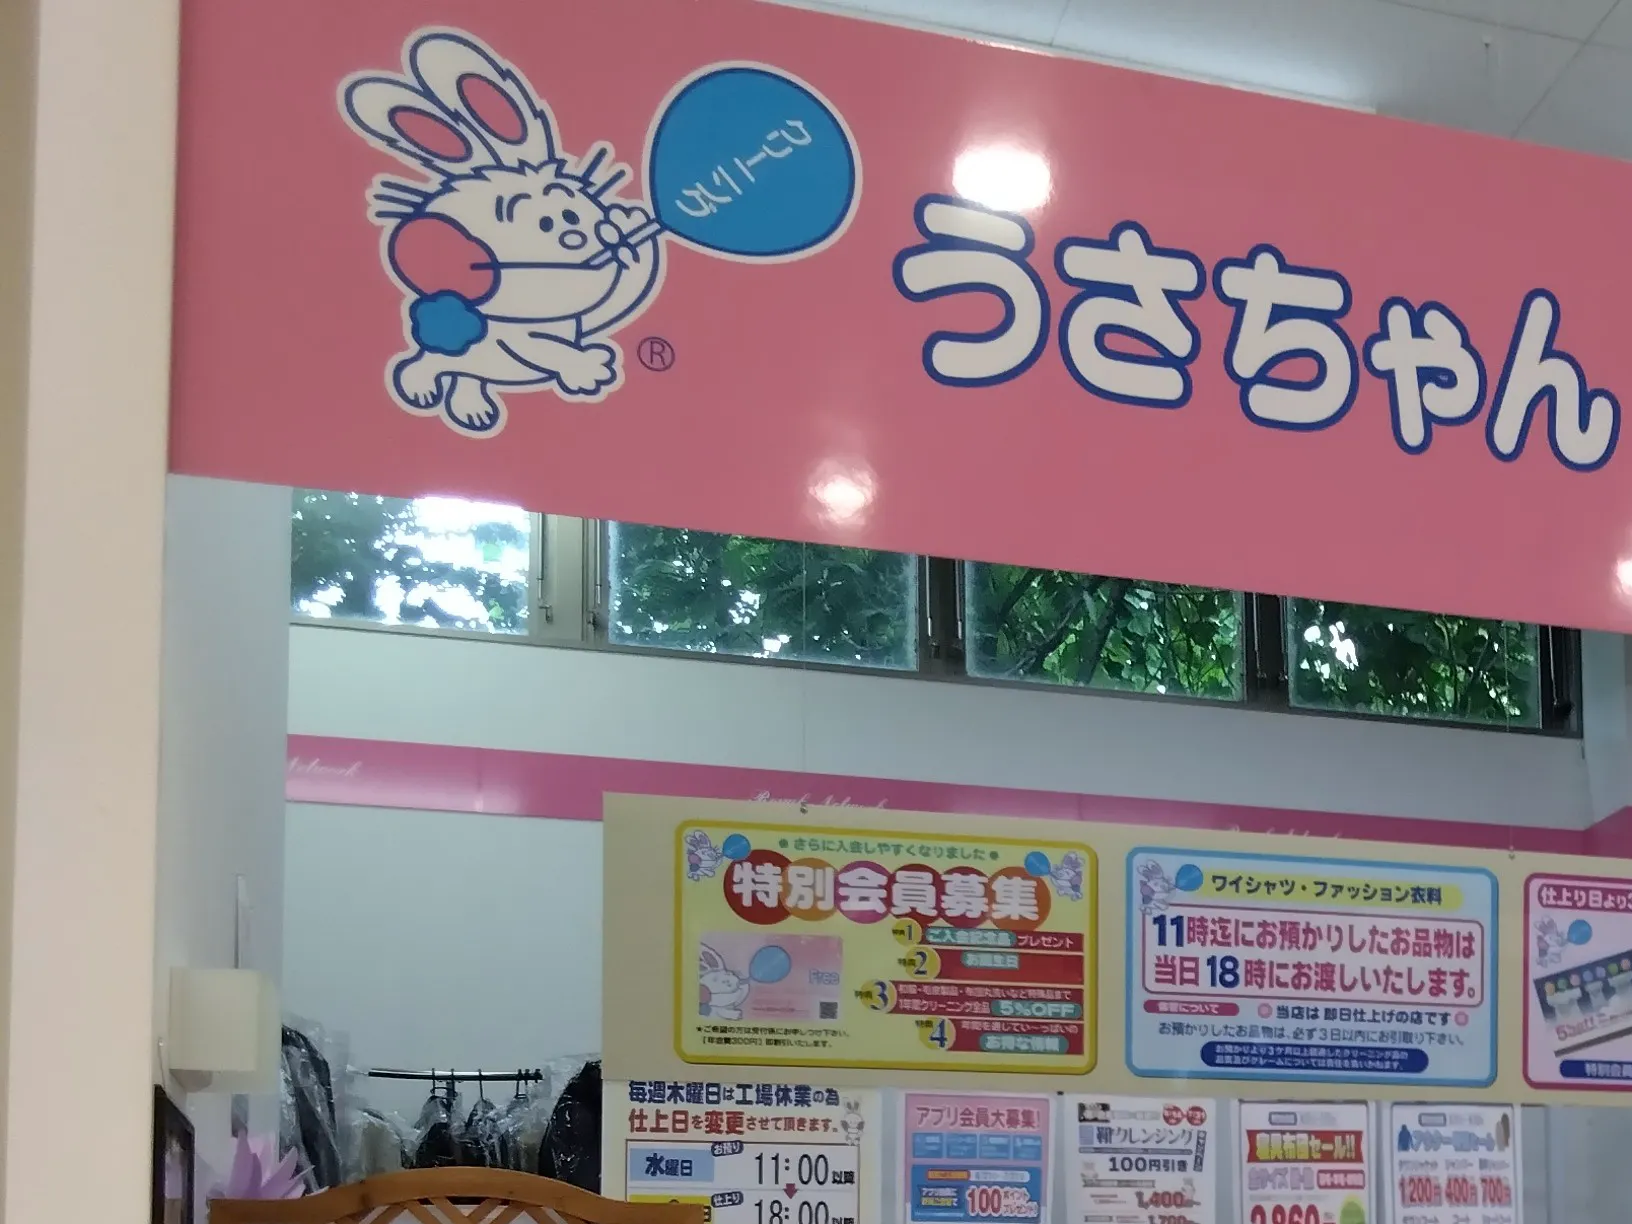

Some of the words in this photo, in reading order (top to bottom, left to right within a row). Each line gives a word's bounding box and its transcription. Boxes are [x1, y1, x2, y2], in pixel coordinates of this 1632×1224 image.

[892, 192, 1621, 472] うさちゃん
[731, 861, 1039, 922] 特別会員募集
[1211, 874, 1443, 906] ワイシャツ・ファッション衣料
[1152, 914, 1476, 960] 11時迄にお預かりしたお品物は
[629, 1080, 840, 1107] 毎週木曜日は工場休業の為
[628, 1108, 839, 1135] 仕上日を変更させて頂きます。
[644, 1152, 694, 1178] 水曜日
[754, 1152, 829, 1186] 11:00
[1108, 1156, 1189, 1173] 100円引き
[967, 1187, 1002, 1214] 100
